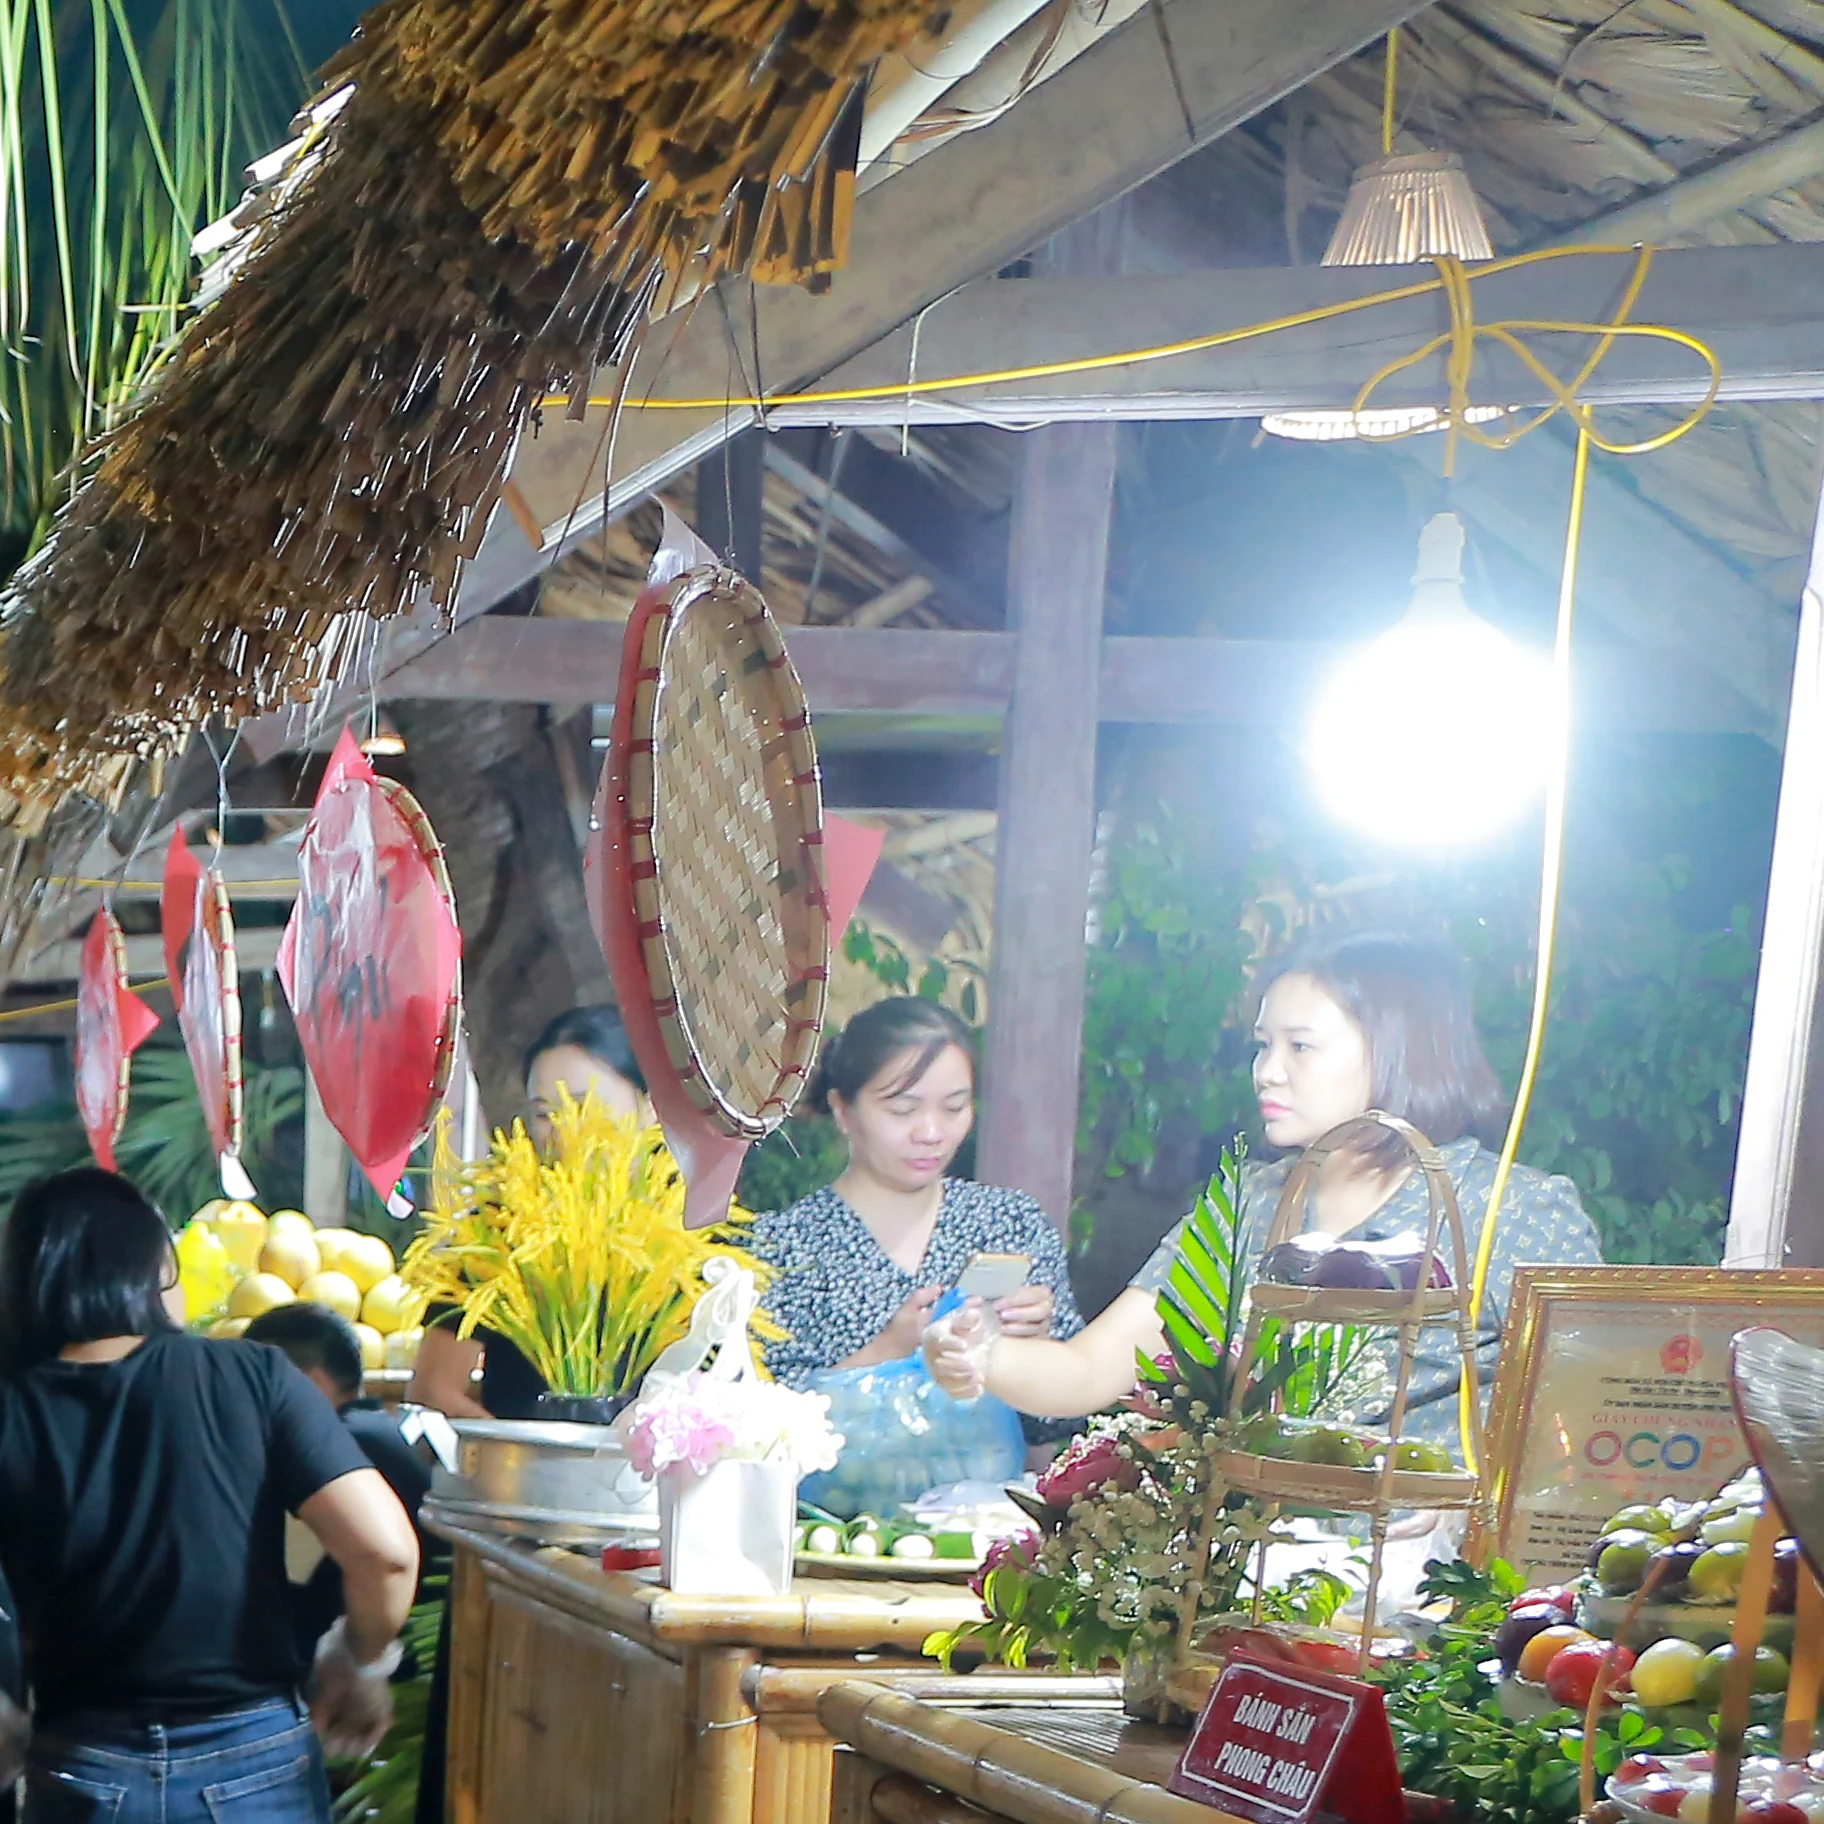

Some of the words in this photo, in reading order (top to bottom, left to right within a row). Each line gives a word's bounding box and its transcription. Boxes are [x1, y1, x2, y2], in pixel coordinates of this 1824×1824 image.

[1584, 1430, 1736, 1473] OCOP
[1232, 1691, 1281, 1732] BÁNH
[1275, 1704, 1318, 1745] SẮN
[1213, 1742, 1271, 1784] PHONG
[1266, 1760, 1317, 1800] CHÂU
